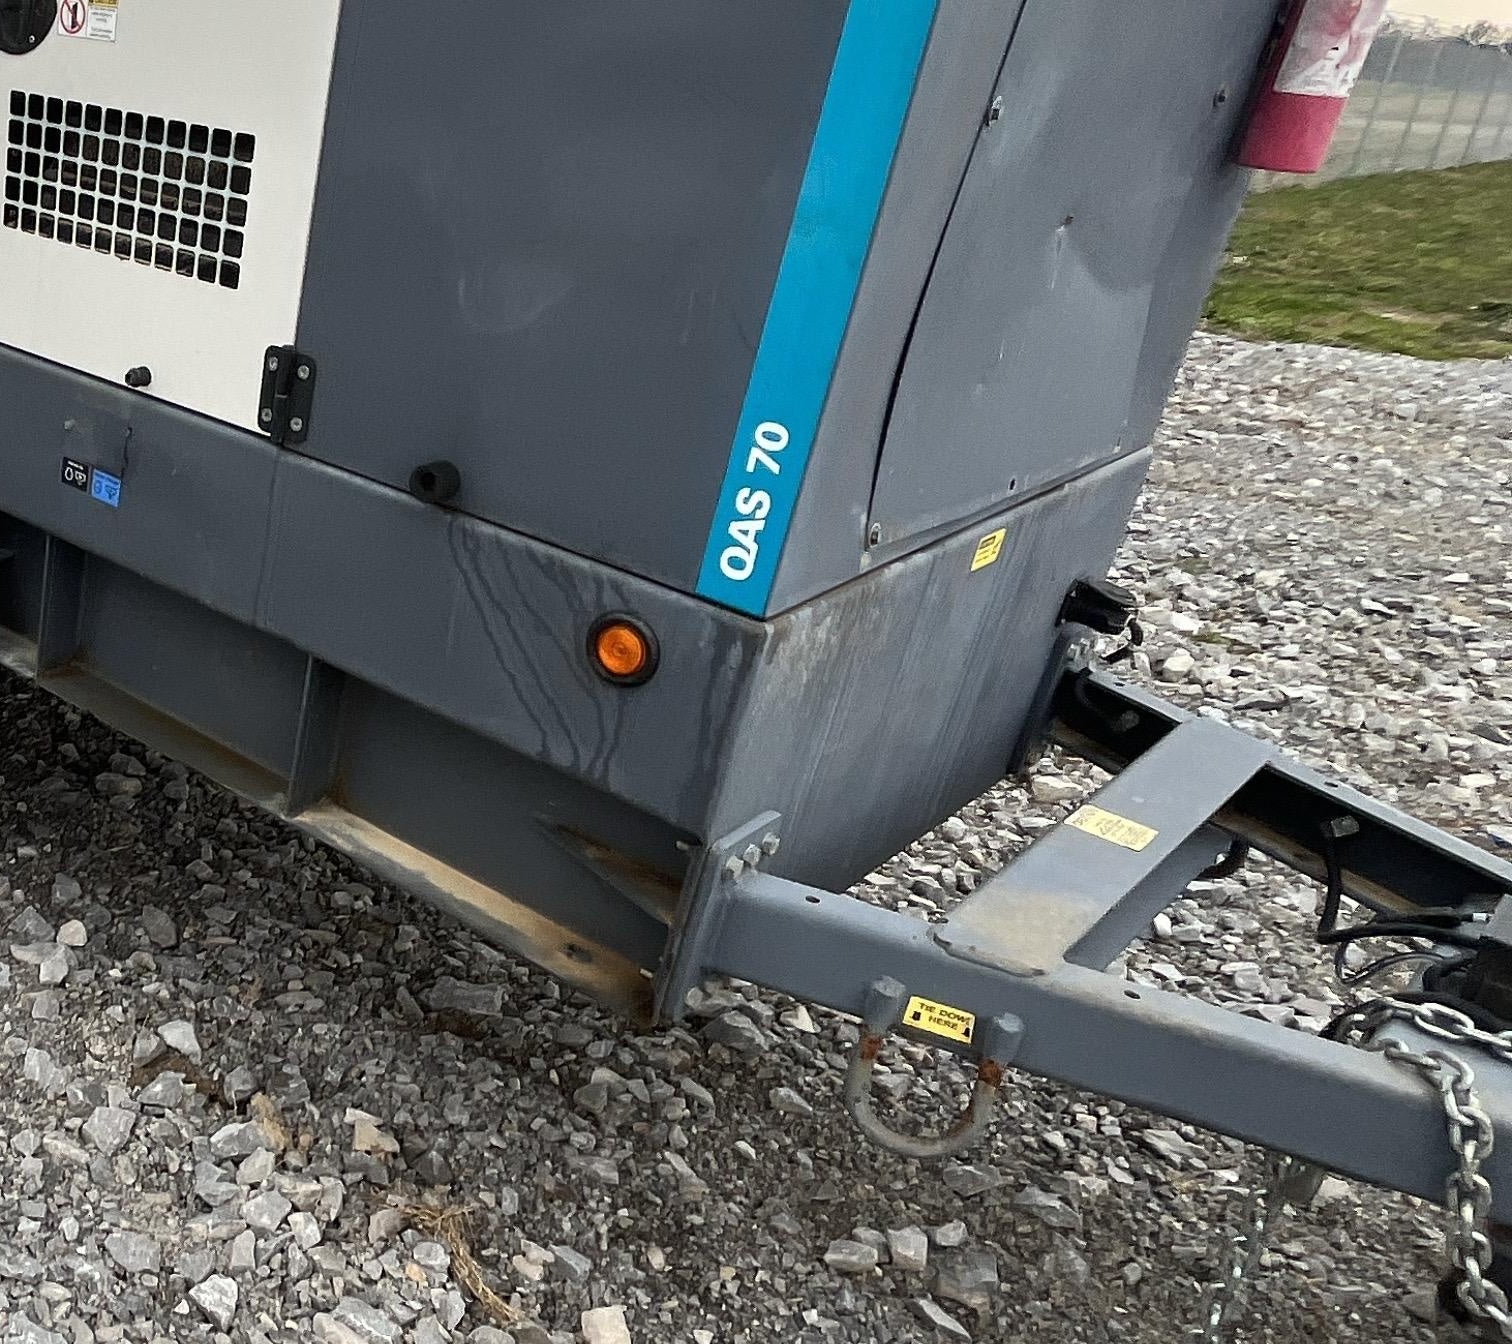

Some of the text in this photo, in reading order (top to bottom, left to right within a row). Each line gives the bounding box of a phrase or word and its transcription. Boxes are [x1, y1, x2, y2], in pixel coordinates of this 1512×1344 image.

[719, 421, 790, 581] QAS 70
[918, 1001, 937, 1013] TIE
[928, 1015, 959, 1031] HERE
